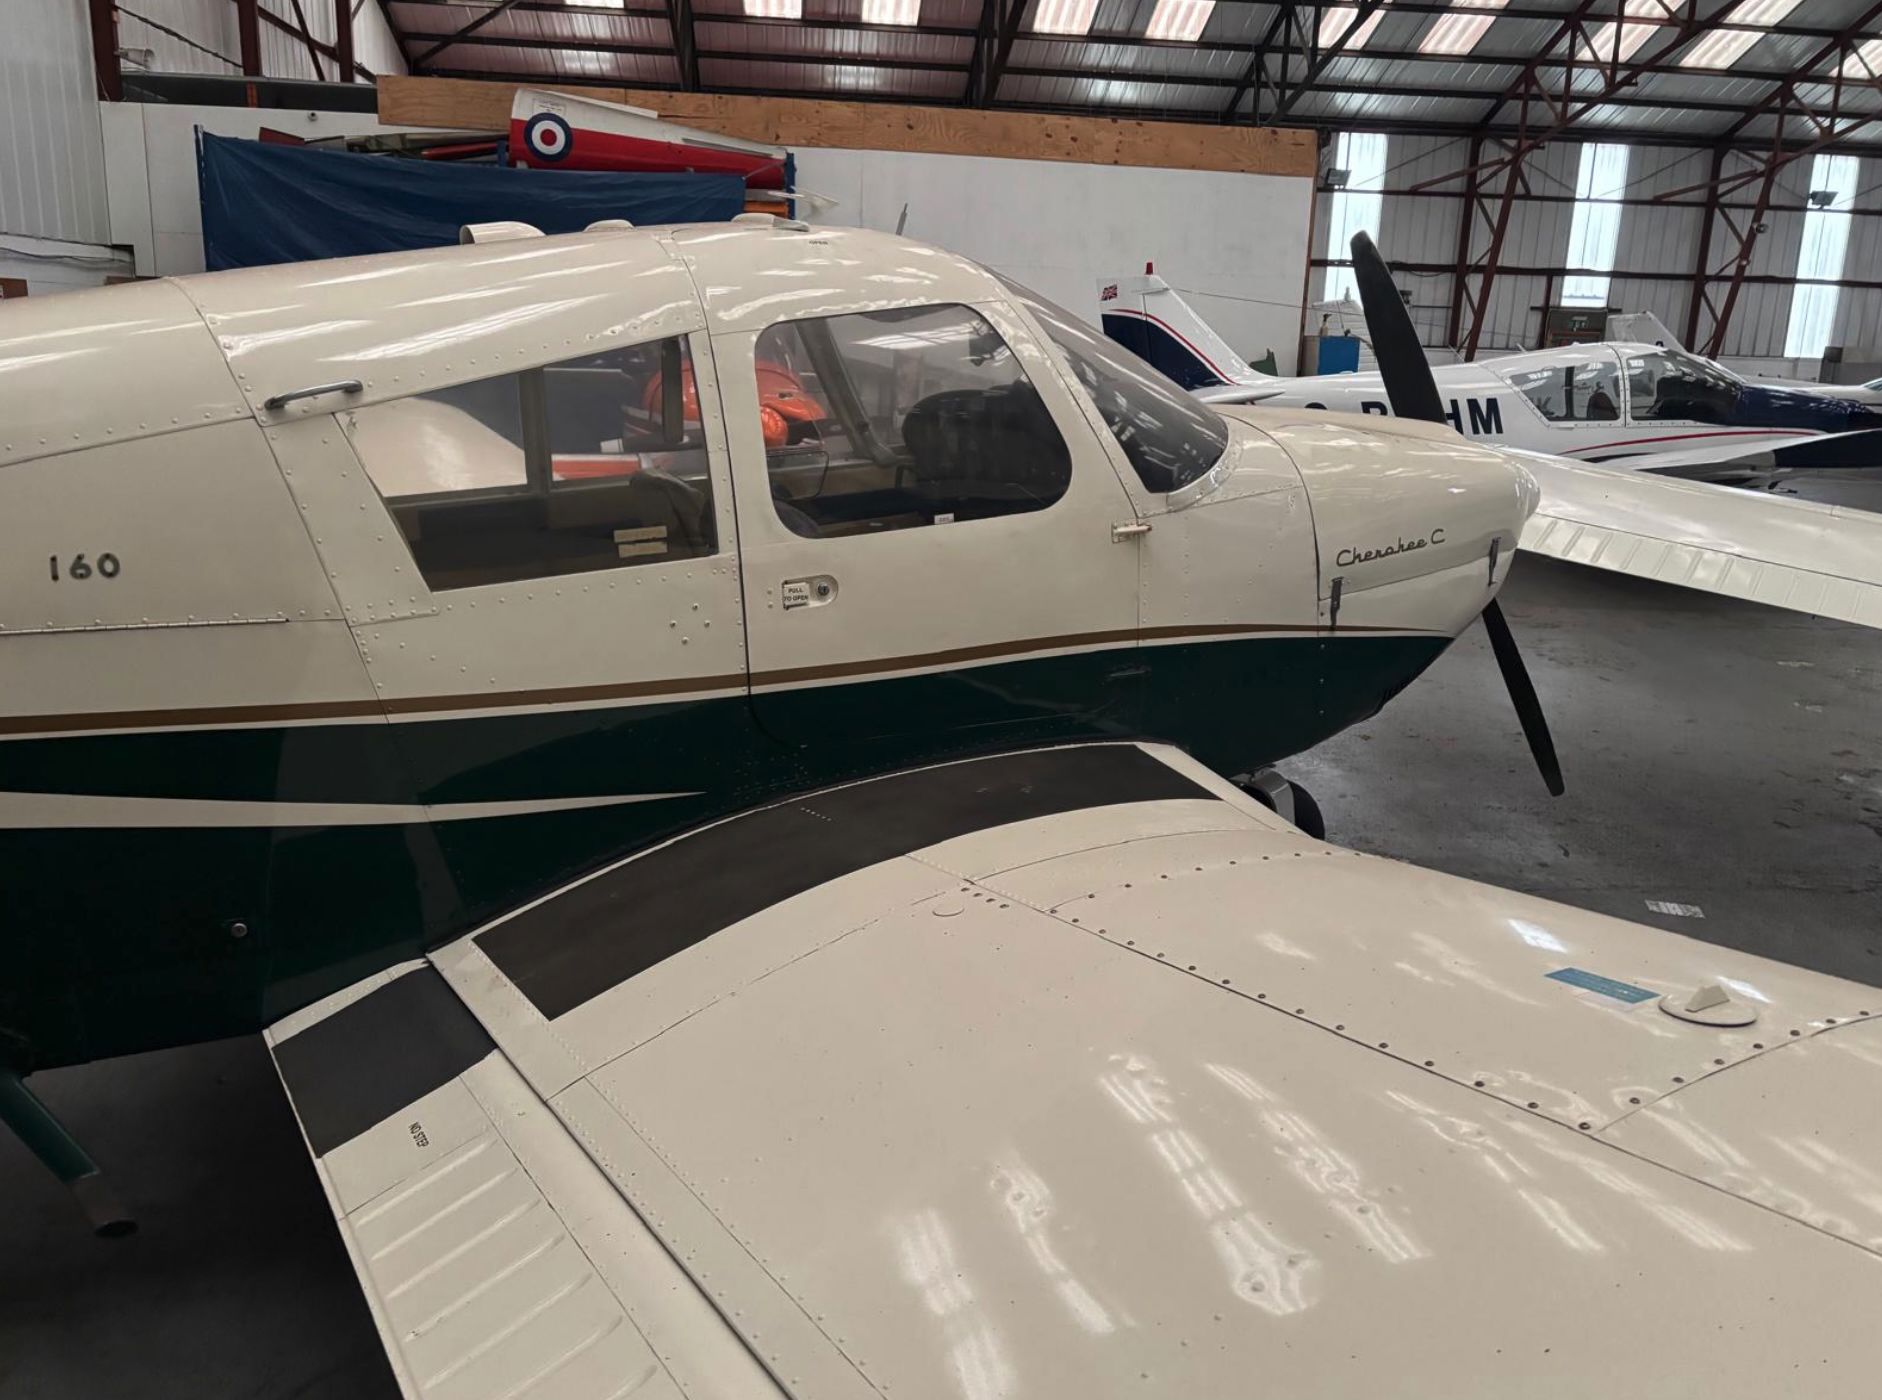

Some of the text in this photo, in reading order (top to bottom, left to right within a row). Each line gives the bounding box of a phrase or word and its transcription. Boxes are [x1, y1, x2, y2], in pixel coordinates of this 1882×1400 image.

[1336, 528, 1446, 567] Cherokee C
[50, 552, 121, 582] 160
[409, 1121, 429, 1147] NO STEP
